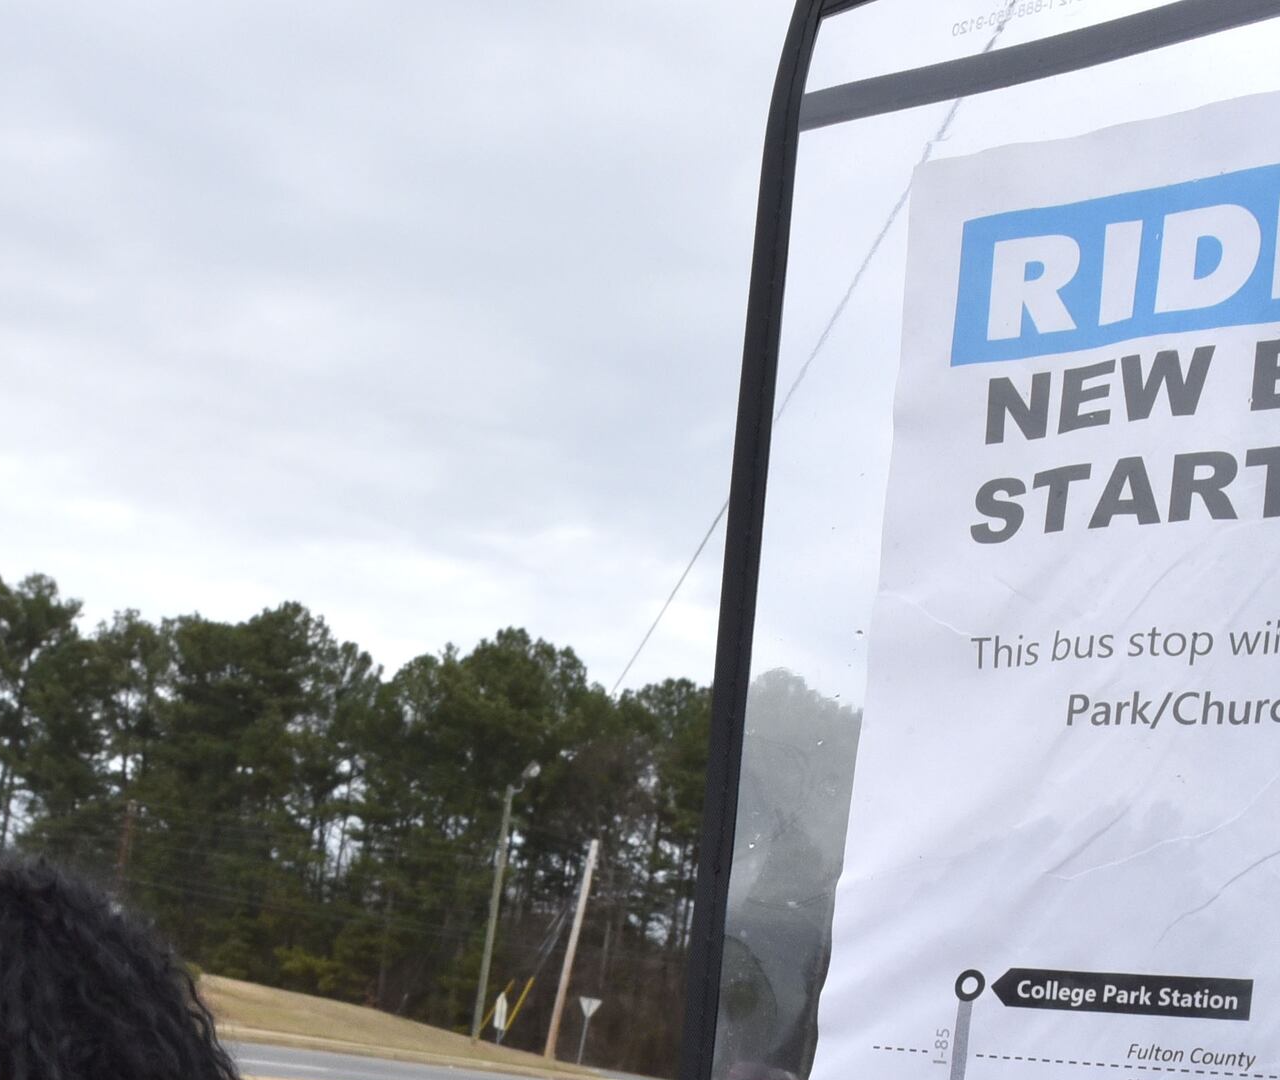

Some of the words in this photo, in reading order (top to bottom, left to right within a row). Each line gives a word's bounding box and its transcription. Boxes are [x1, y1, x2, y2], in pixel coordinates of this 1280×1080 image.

[985, 346, 1214, 445] NEW
[970, 636, 1039, 669] This
[1051, 630, 1114, 661] bus
[1128, 625, 1214, 665] stop
[1017, 981, 1097, 1007] College
[1103, 984, 1151, 1005] Park
[1158, 988, 1239, 1011] Station
[933, 1028, 950, 1064] I-85
[1127, 1043, 1184, 1063] Fulton
[1189, 1047, 1256, 1070] County
